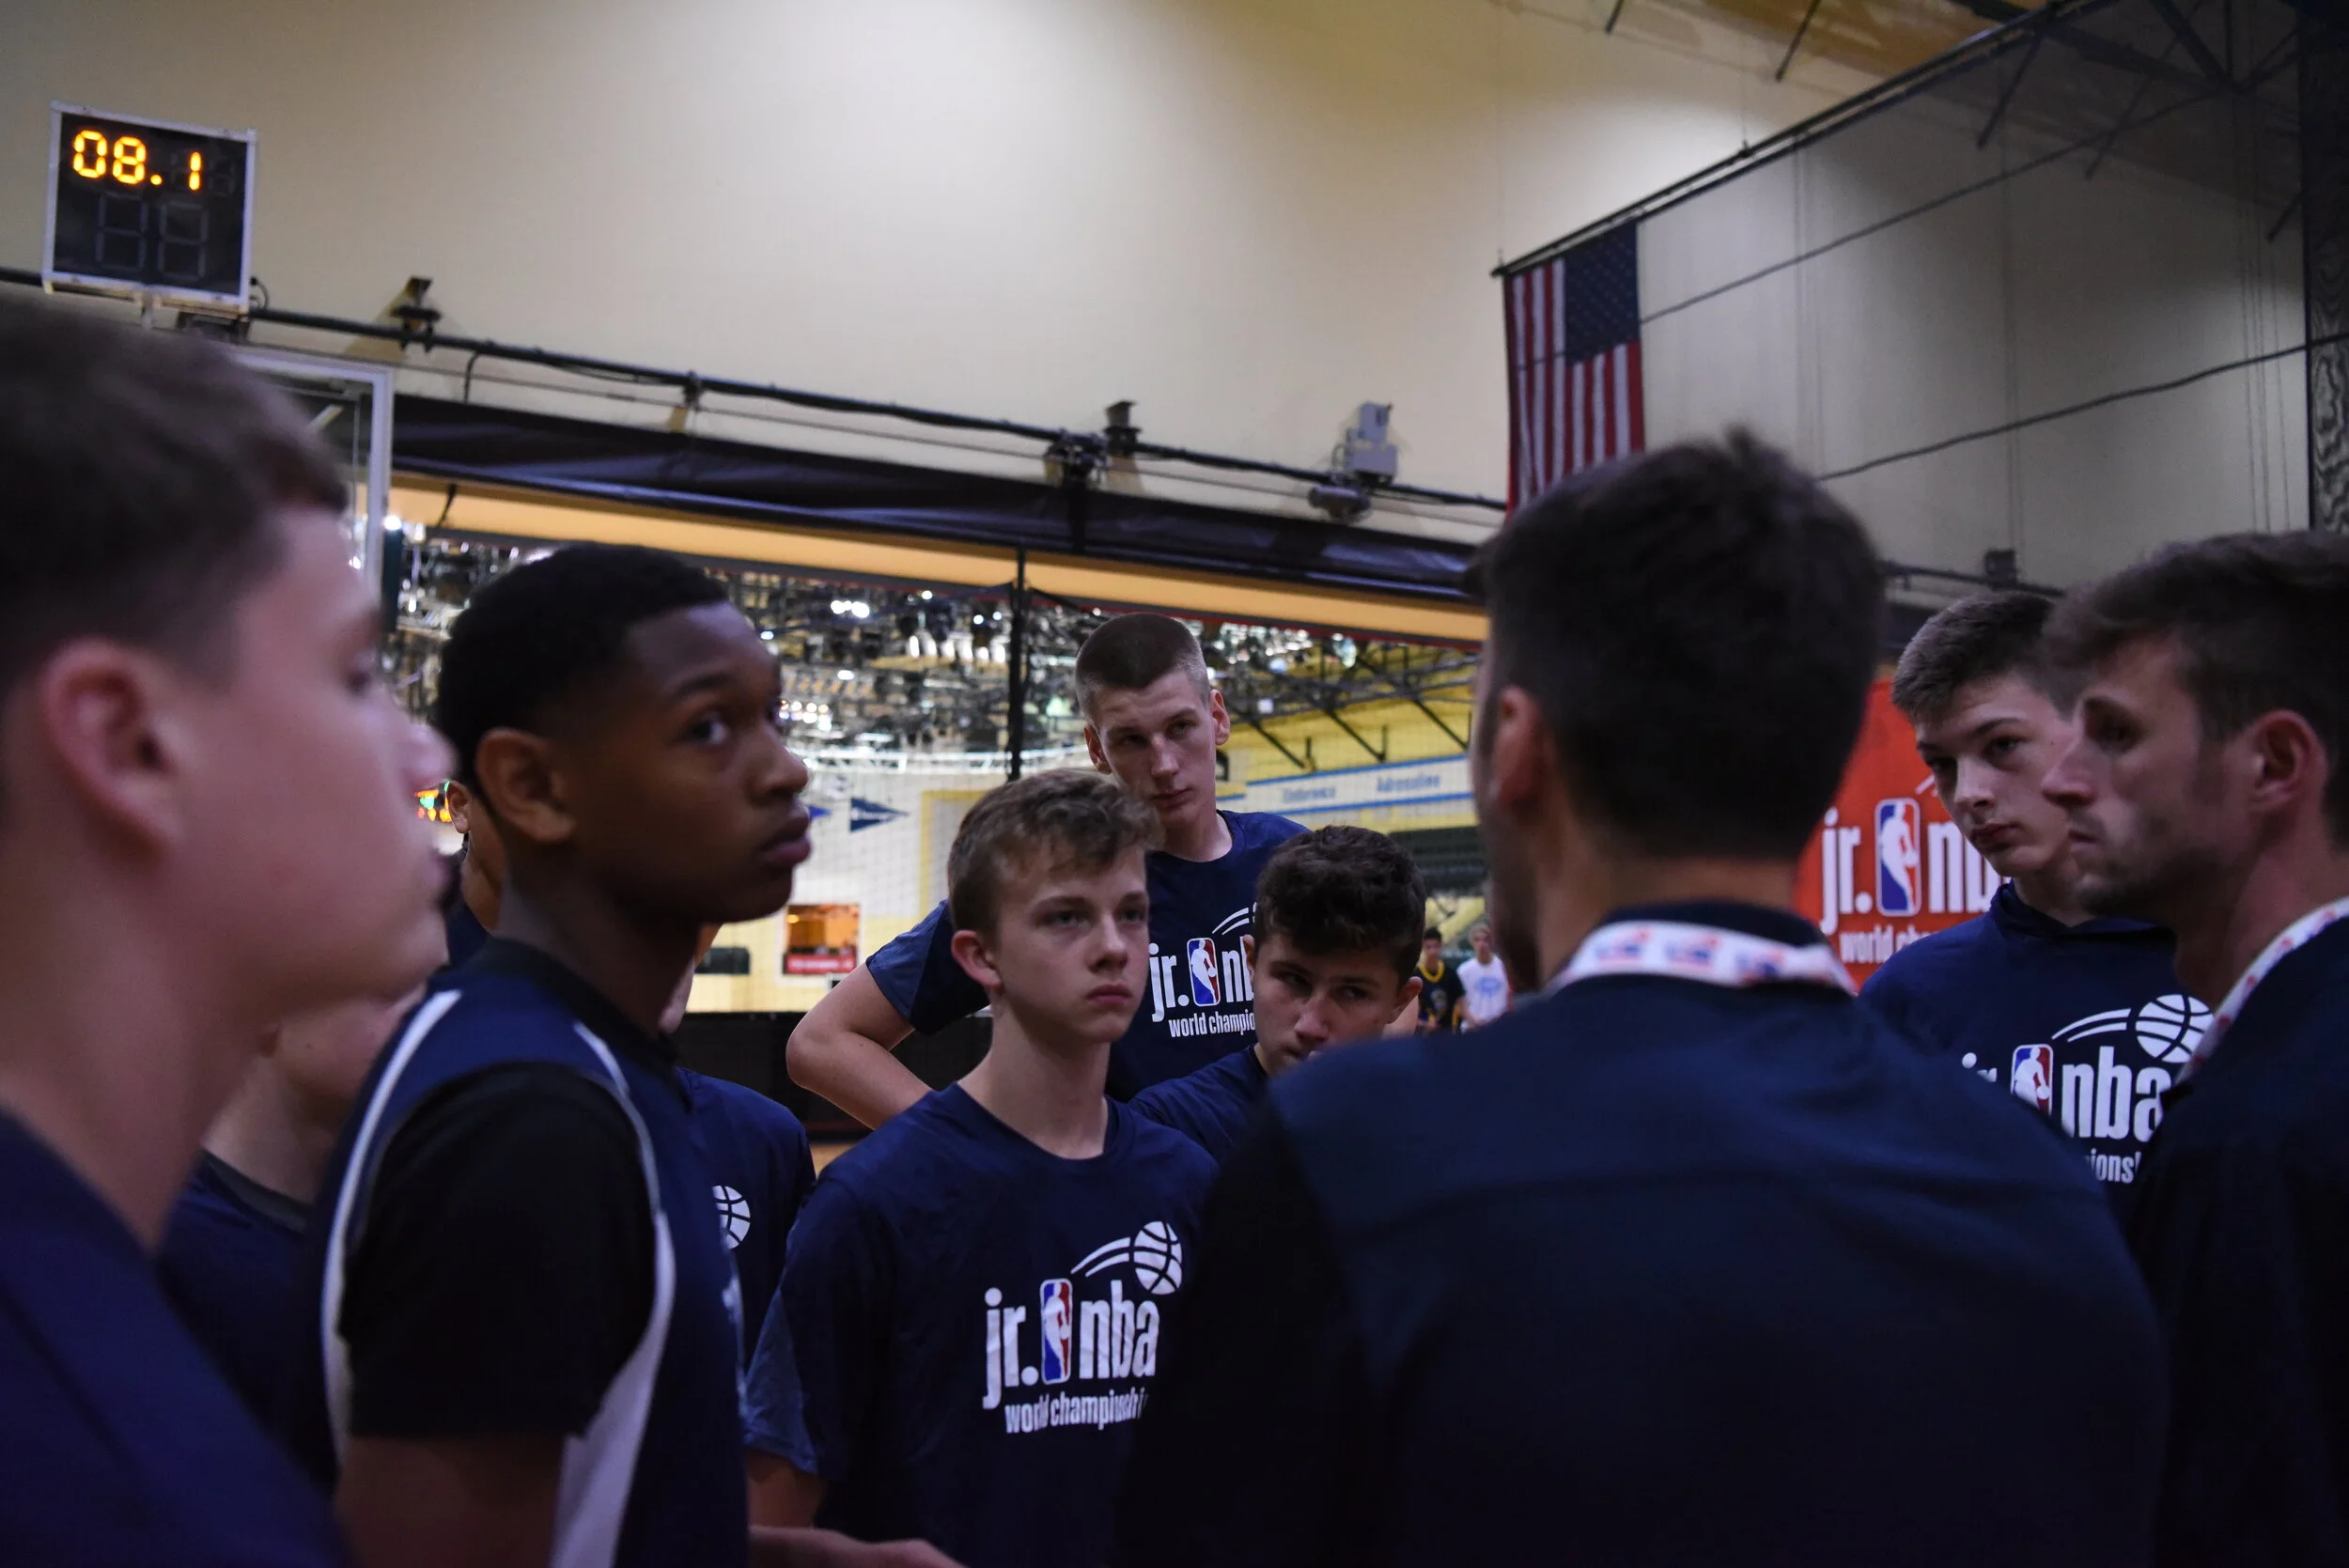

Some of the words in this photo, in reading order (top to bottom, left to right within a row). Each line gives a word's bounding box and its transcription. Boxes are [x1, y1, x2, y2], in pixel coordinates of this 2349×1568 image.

[1820, 807, 1873, 936] jr.
[1927, 820, 2011, 913] nb
[1148, 942, 1190, 1022] jr.
[1168, 1012, 1207, 1038] world
[1208, 1008, 1255, 1036] champio
[2061, 1046, 2171, 1142] nba
[983, 1287, 1039, 1409] jr.
[1079, 1280, 1159, 1379] nba
